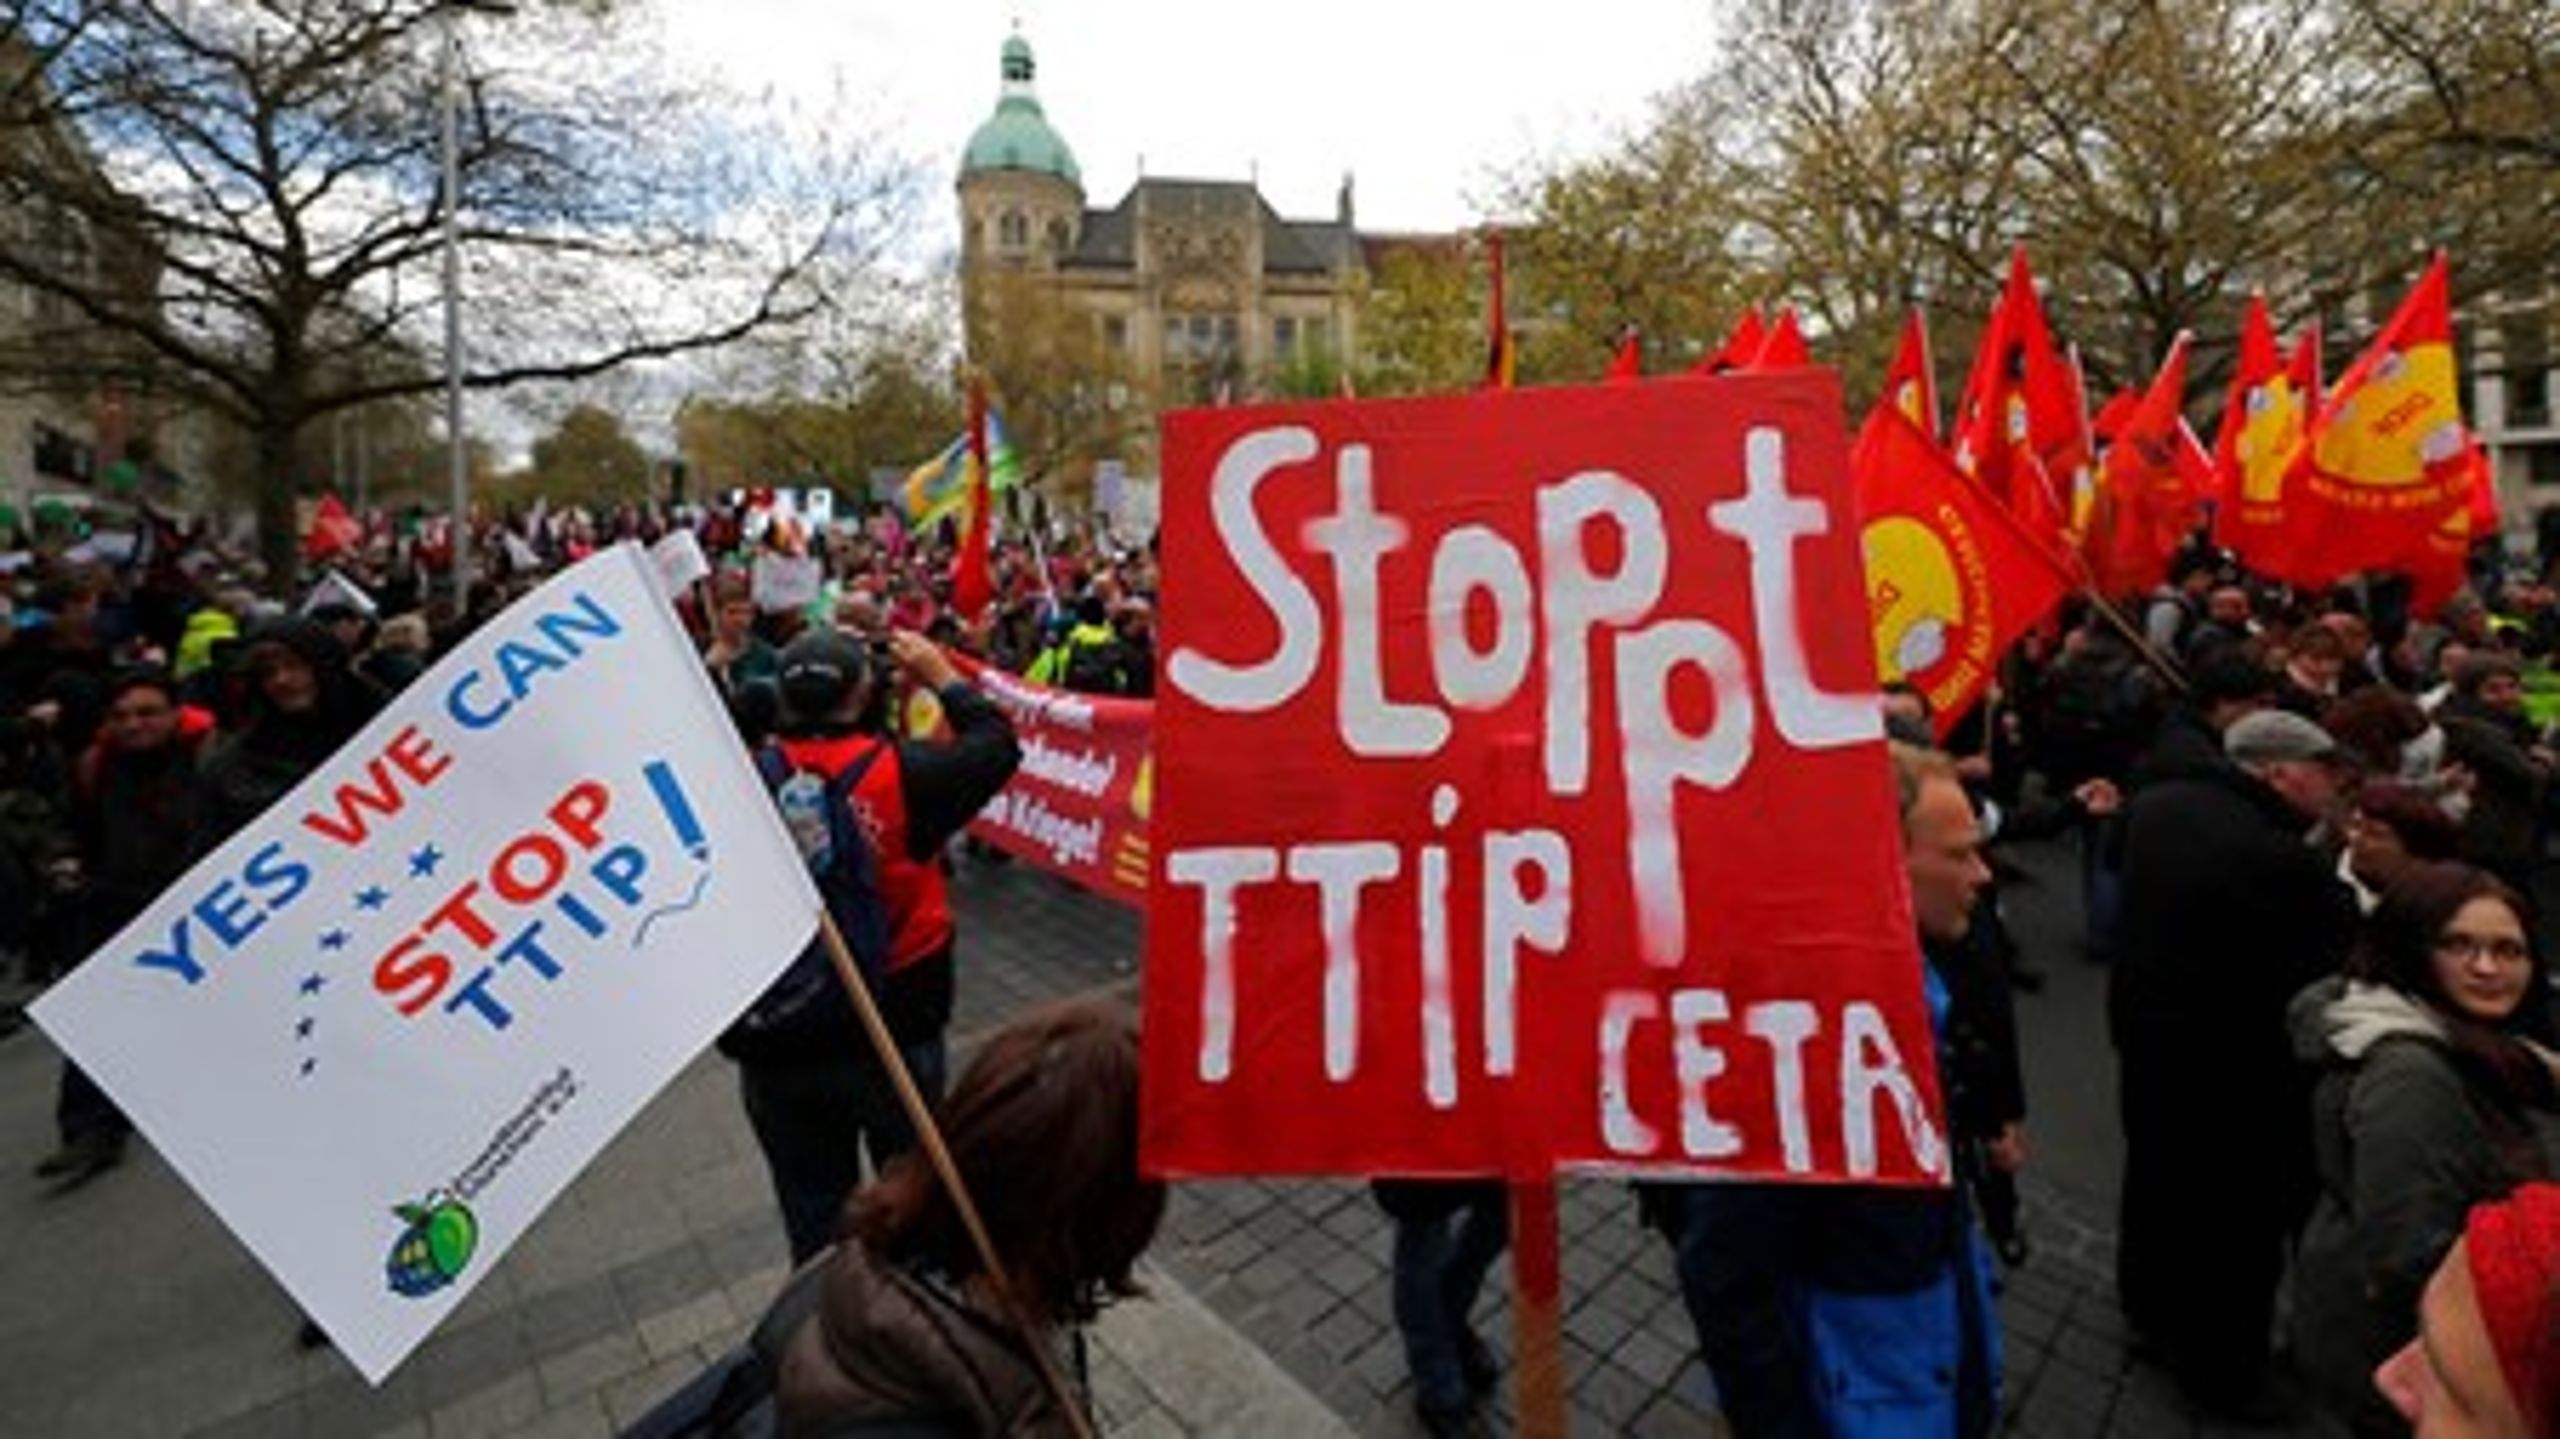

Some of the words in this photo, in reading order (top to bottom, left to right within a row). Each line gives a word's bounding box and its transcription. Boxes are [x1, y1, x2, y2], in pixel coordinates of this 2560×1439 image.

[135, 842, 311, 985] YES
[302, 725, 454, 848] WE
[446, 593, 622, 730] CAN
[1166, 425, 1887, 968] Stoppt
[373, 780, 612, 1016] STOP
[1598, 987, 1947, 1177] CETA
